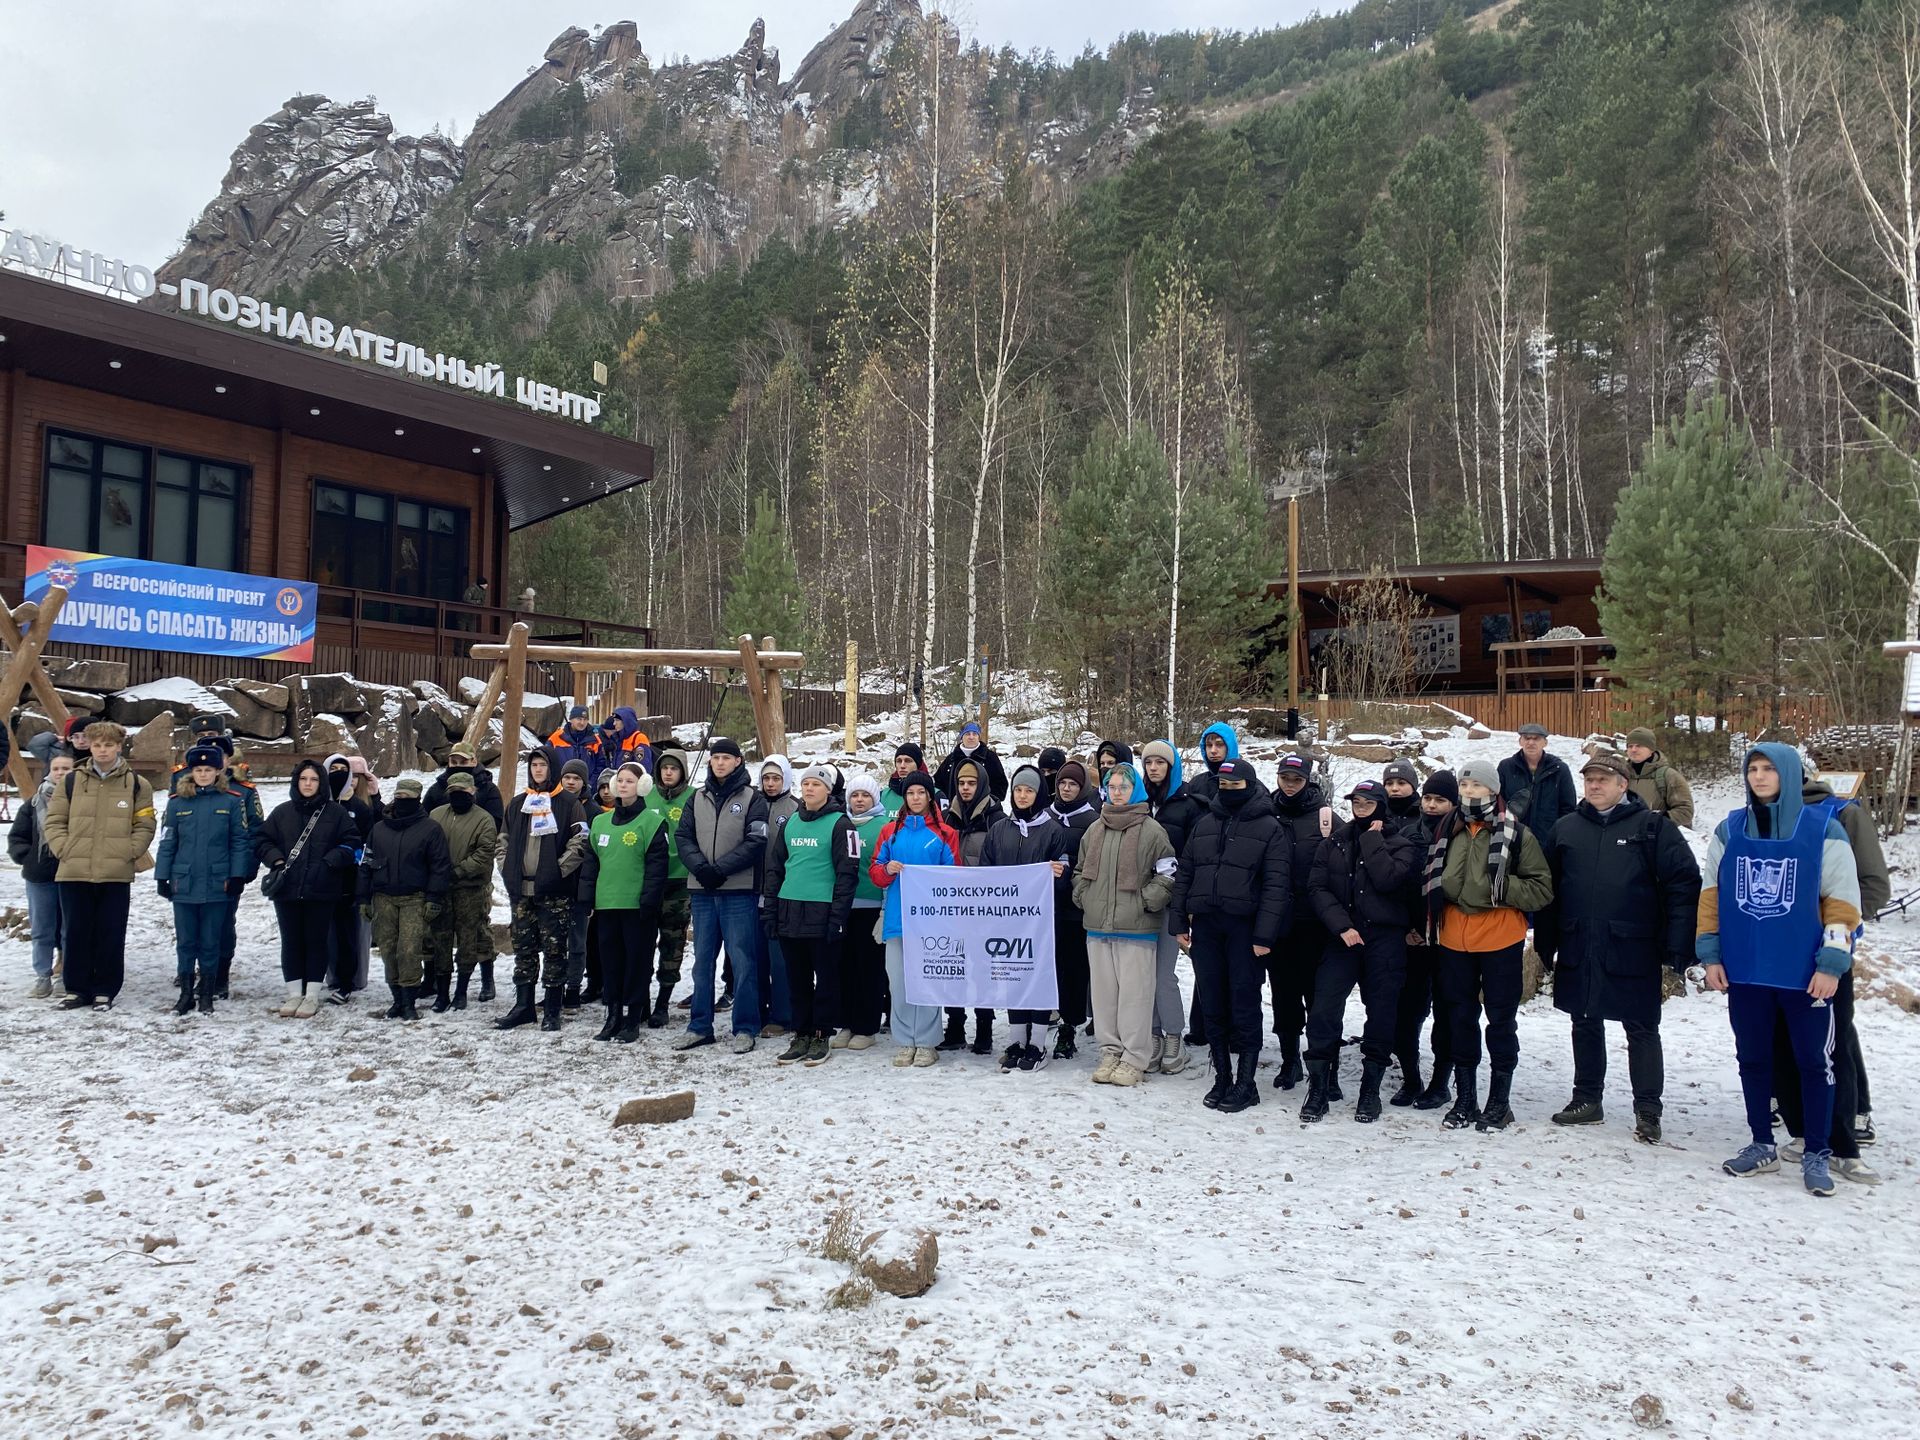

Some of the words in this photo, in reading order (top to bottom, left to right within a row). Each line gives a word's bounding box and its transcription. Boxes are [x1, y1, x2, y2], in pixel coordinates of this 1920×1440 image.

[0, 229, 504, 398] АУЧНО-ПОЗНАВАТЕЛЬНЫЙ
[516, 377, 601, 423] ЦЕНТР
[92, 572, 214, 601] ВСЕРОССИЙСКИЙ
[217, 587, 266, 607] ПРОЕКТ
[146, 608, 227, 640] СПАСАТЬ
[760, 823, 767, 836] 1
[790, 838, 818, 847] КБМК
[849, 831, 858, 856] 1
[932, 887, 948, 897] 100
[949, 884, 1019, 897] ЭКСКУРСИЙ
[910, 905, 917, 916] В
[920, 905, 975, 916] 100-ЛЕТИЕ
[977, 905, 1041, 917] НАЦПАРКА
[923, 965, 966, 975] СТОЛБЫ
